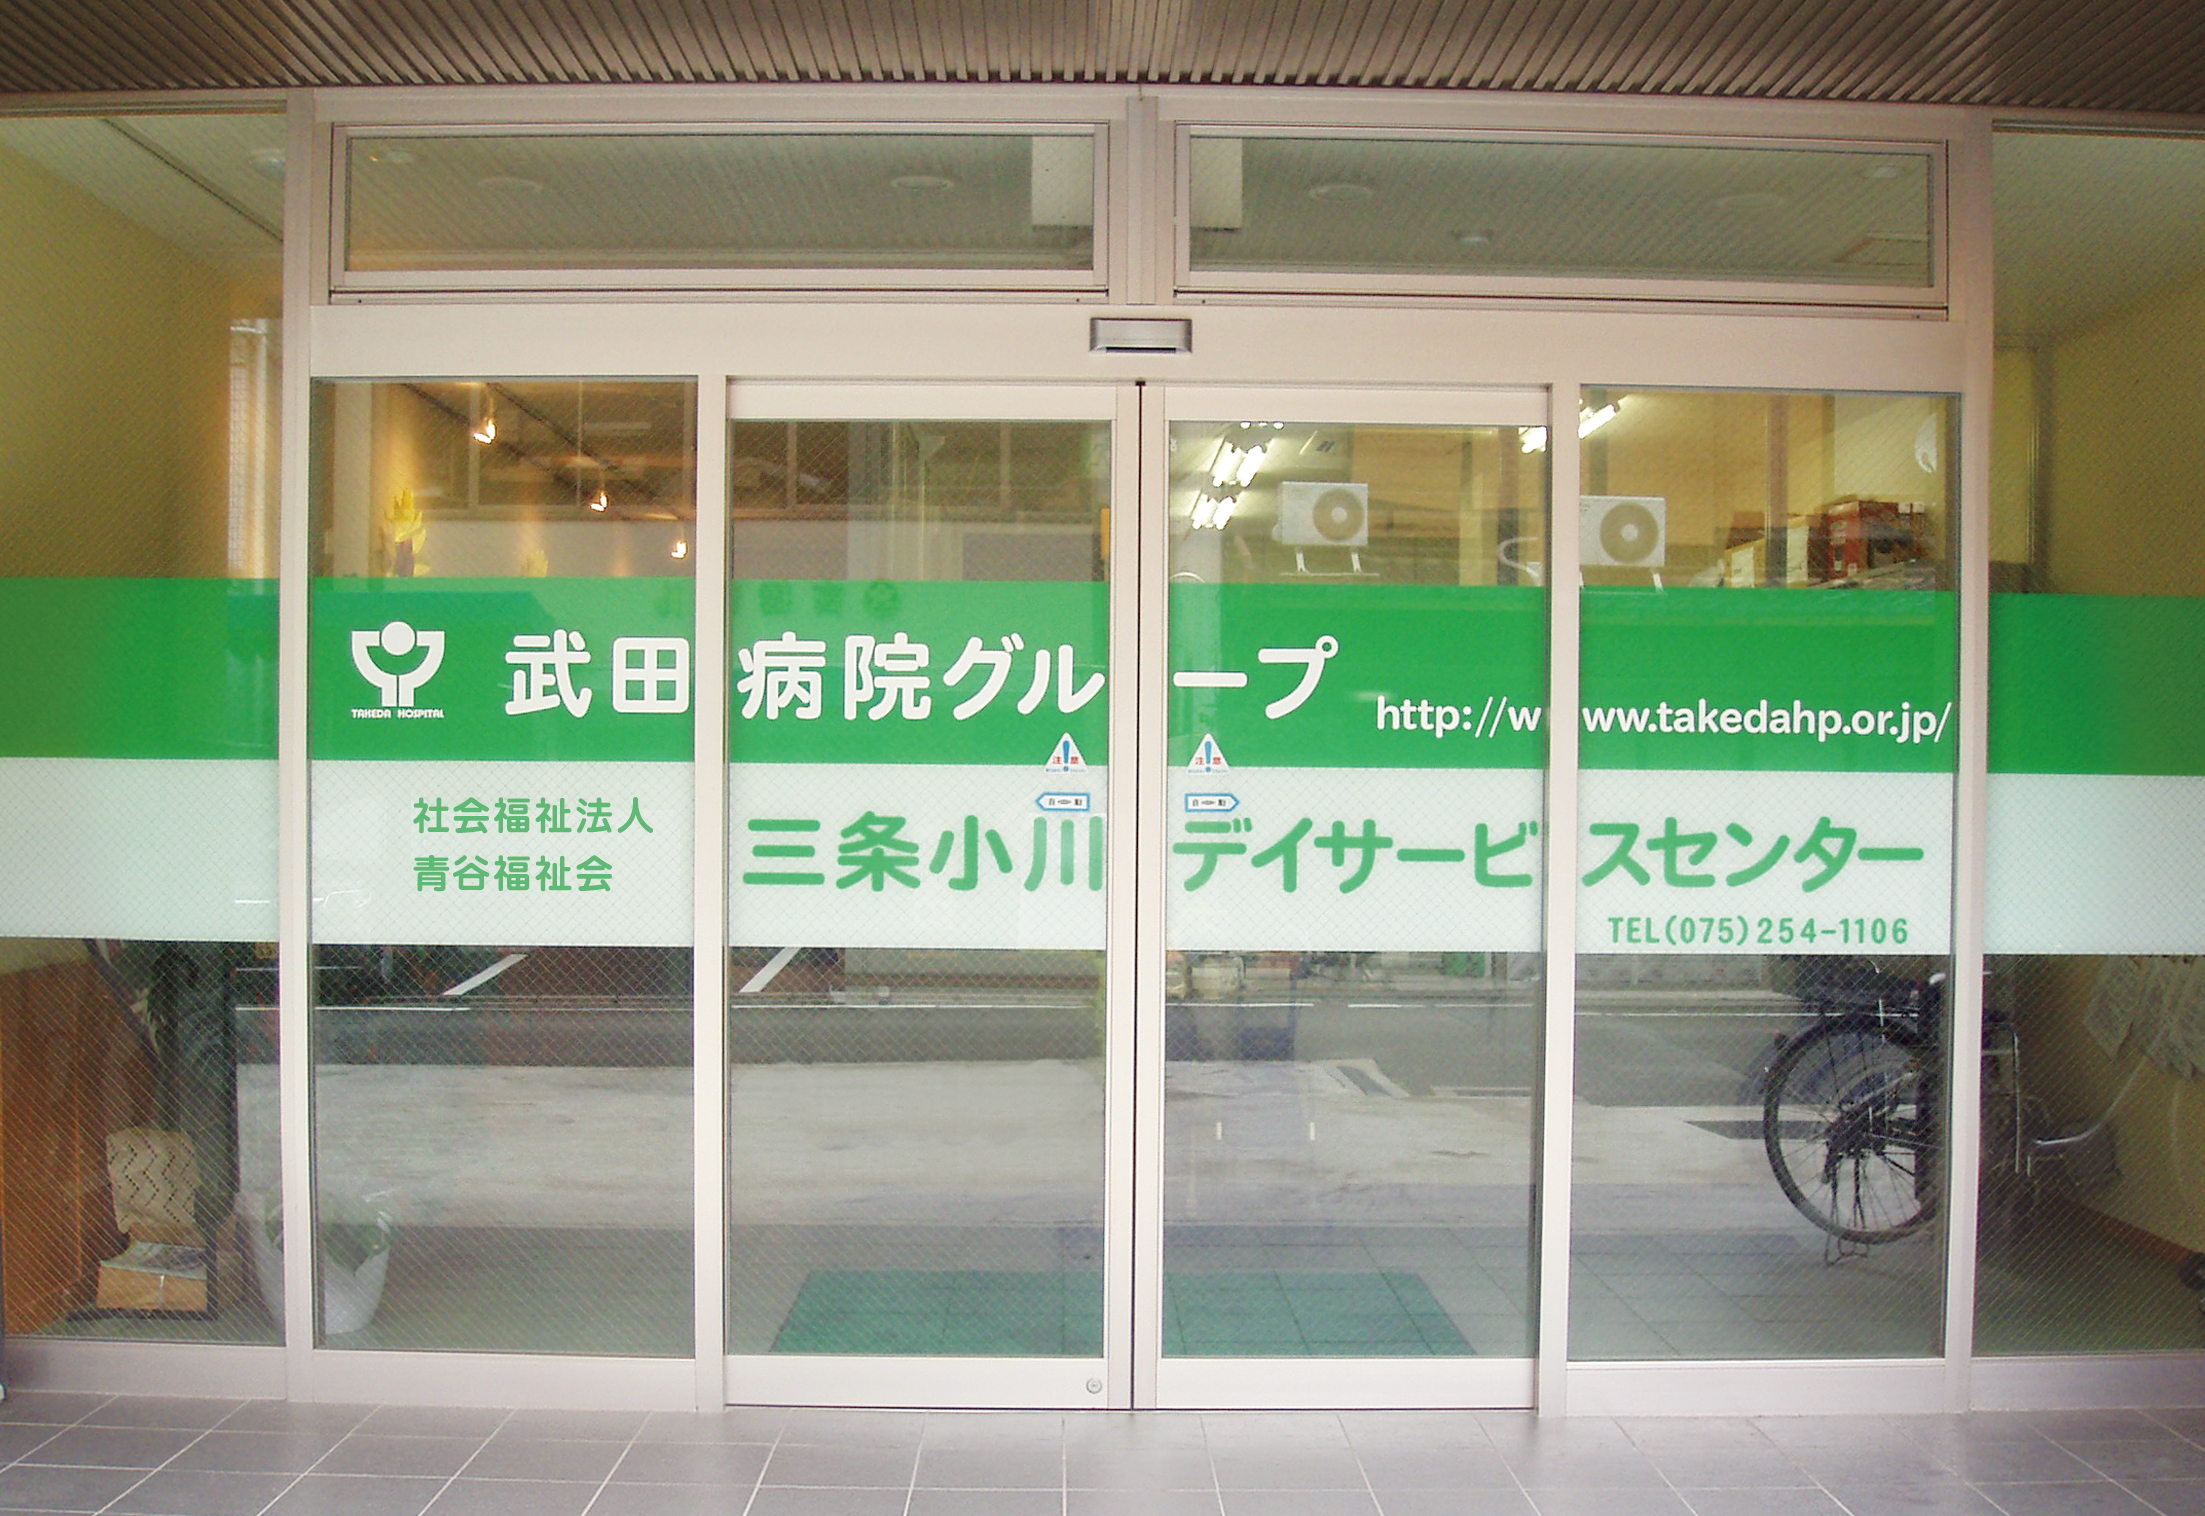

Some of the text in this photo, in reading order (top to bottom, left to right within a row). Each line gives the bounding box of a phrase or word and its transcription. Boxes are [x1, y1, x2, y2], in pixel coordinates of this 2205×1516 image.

[504, 629, 1339, 721] 武田病院グループ
[351, 708, 445, 719] TAKEDA HOSPITAL
[1377, 695, 1952, 744] http://www.takedahp.or.jp/
[412, 797, 654, 834] 社会福祉法人
[413, 854, 613, 892] 青谷福祉会
[742, 810, 1925, 894] 三条小川デイサービスセンター
